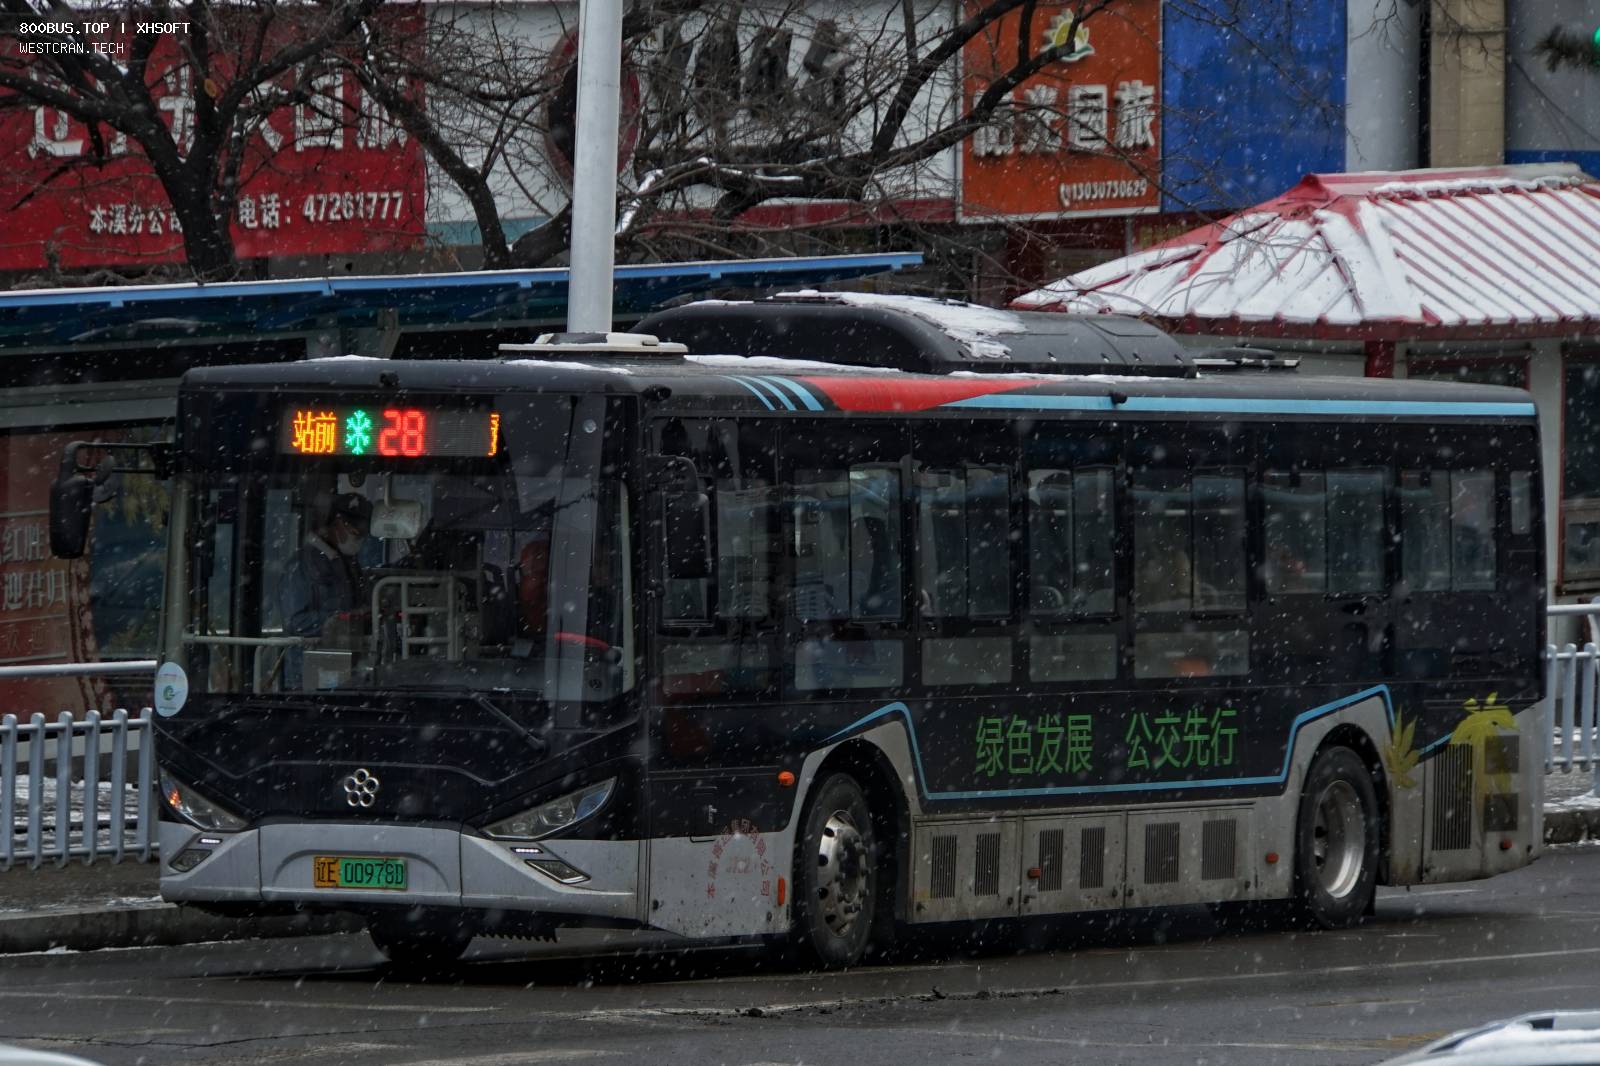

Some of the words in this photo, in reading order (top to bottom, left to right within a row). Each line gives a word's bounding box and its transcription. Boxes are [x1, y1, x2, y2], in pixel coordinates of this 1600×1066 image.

[292, 411, 337, 454] 站前
[379, 410, 426, 457] 28
[975, 713, 1094, 777] 绿色发展
[1125, 707, 1239, 769] 公交先行
